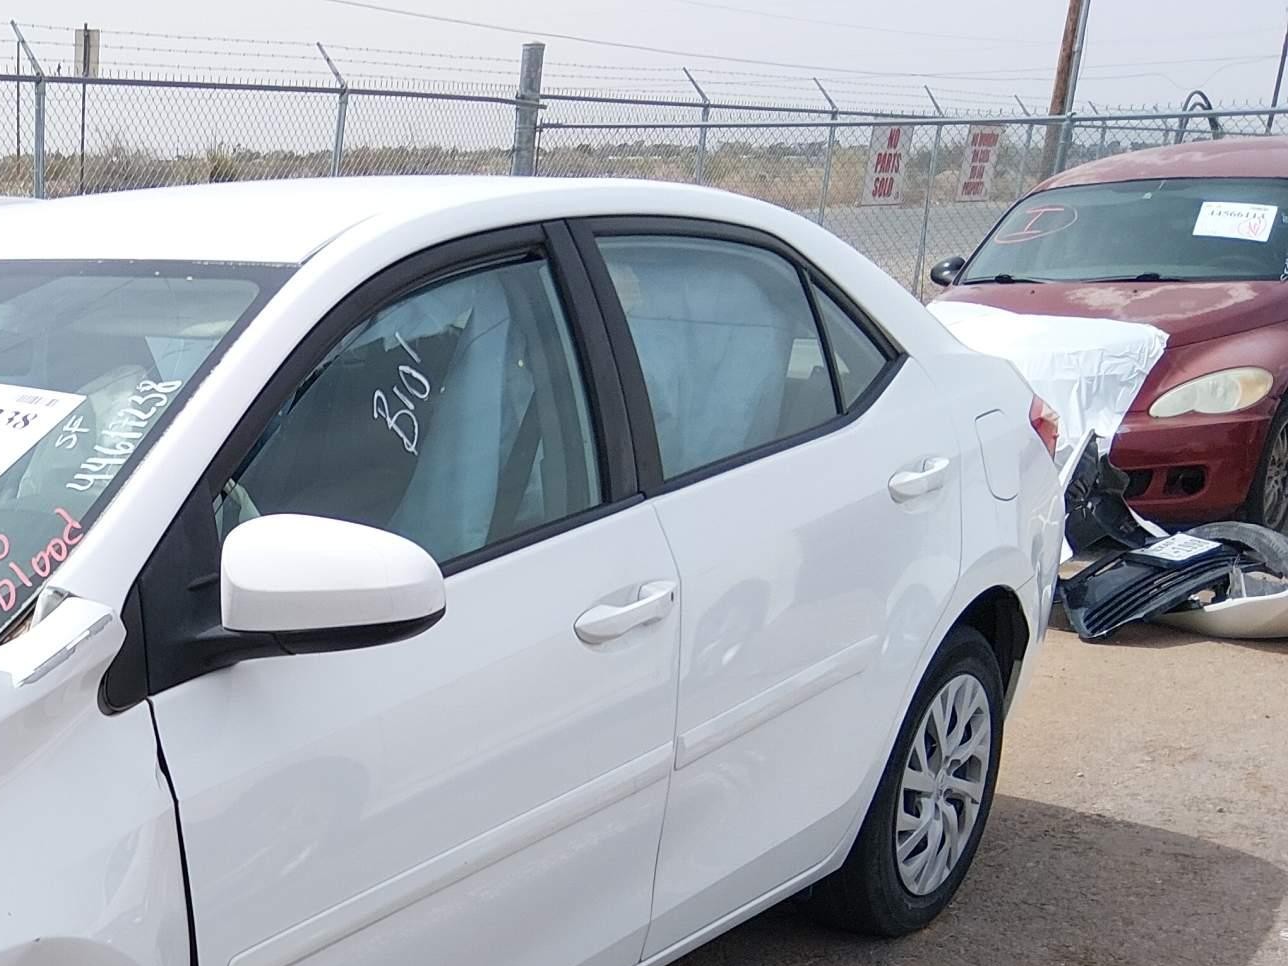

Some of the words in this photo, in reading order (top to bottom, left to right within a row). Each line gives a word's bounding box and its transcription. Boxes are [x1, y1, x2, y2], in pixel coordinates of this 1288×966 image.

[887, 128, 900, 149] NO
[874, 152, 902, 173] PARTS
[872, 177, 894, 198] SOLD
[54, 414, 91, 449] SF
[65, 379, 183, 491] 44617238
